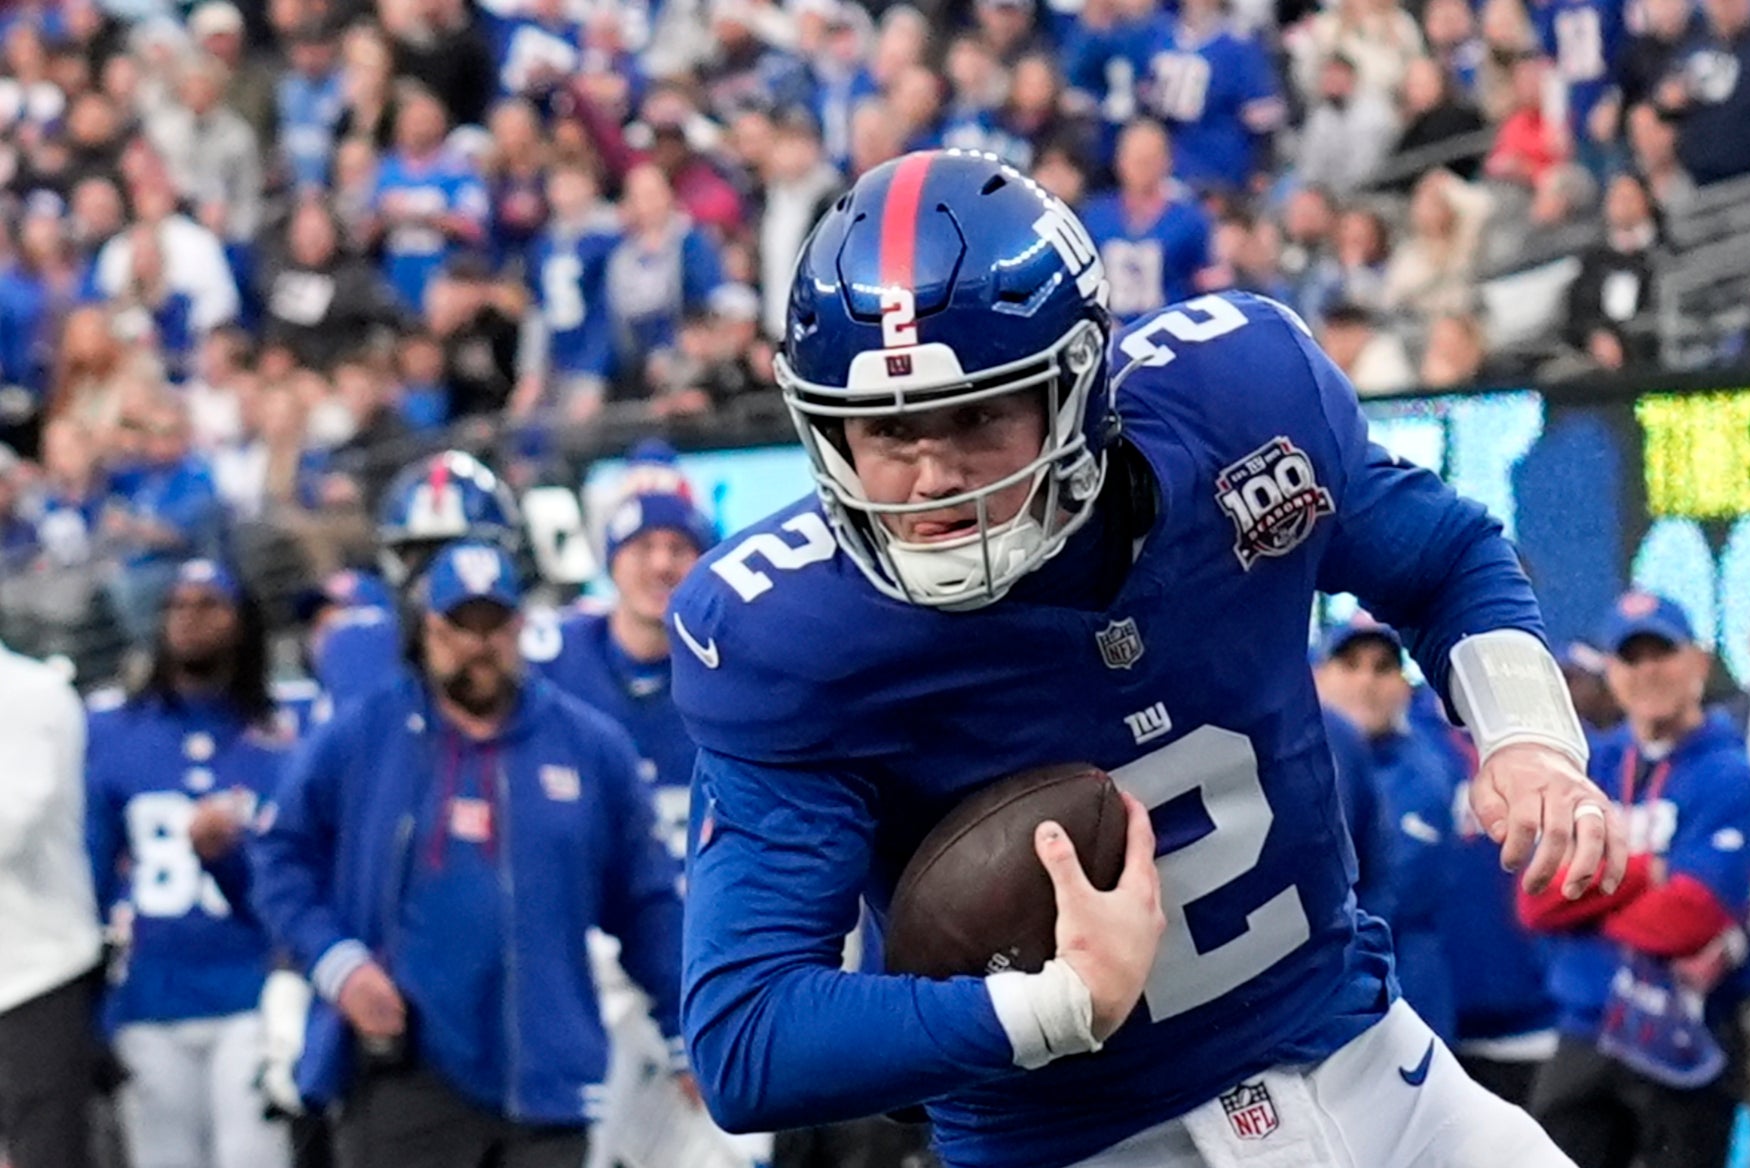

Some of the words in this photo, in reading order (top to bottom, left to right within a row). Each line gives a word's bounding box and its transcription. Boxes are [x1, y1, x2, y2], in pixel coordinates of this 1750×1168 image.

[881, 286, 917, 347] 2
[1120, 294, 1249, 366] 2
[1222, 454, 1312, 534] 100
[709, 511, 837, 603] 2
[1110, 724, 1310, 1023] 2
[1233, 1105, 1276, 1136] NFL
